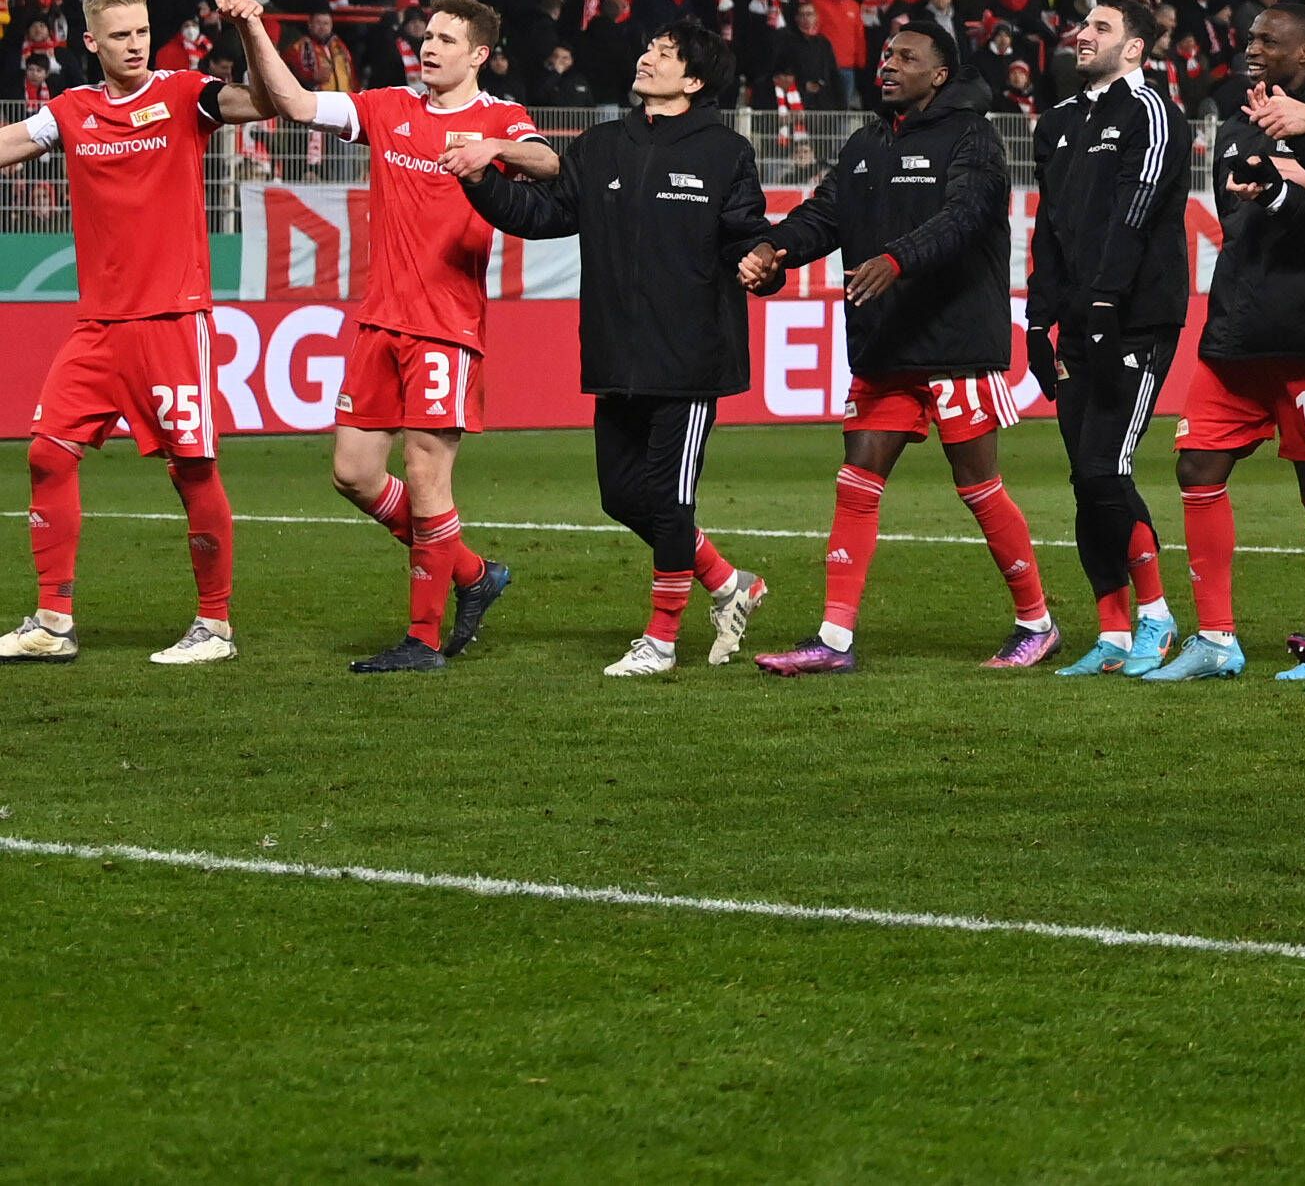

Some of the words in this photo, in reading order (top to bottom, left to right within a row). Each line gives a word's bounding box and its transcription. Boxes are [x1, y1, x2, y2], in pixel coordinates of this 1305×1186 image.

[75, 135, 168, 156] AROUNDTOWN
[384, 149, 449, 175] AROUNDTO
[656, 192, 709, 203] AROUNDTOWN
[424, 351, 450, 400] 3
[151, 385, 201, 431] 25
